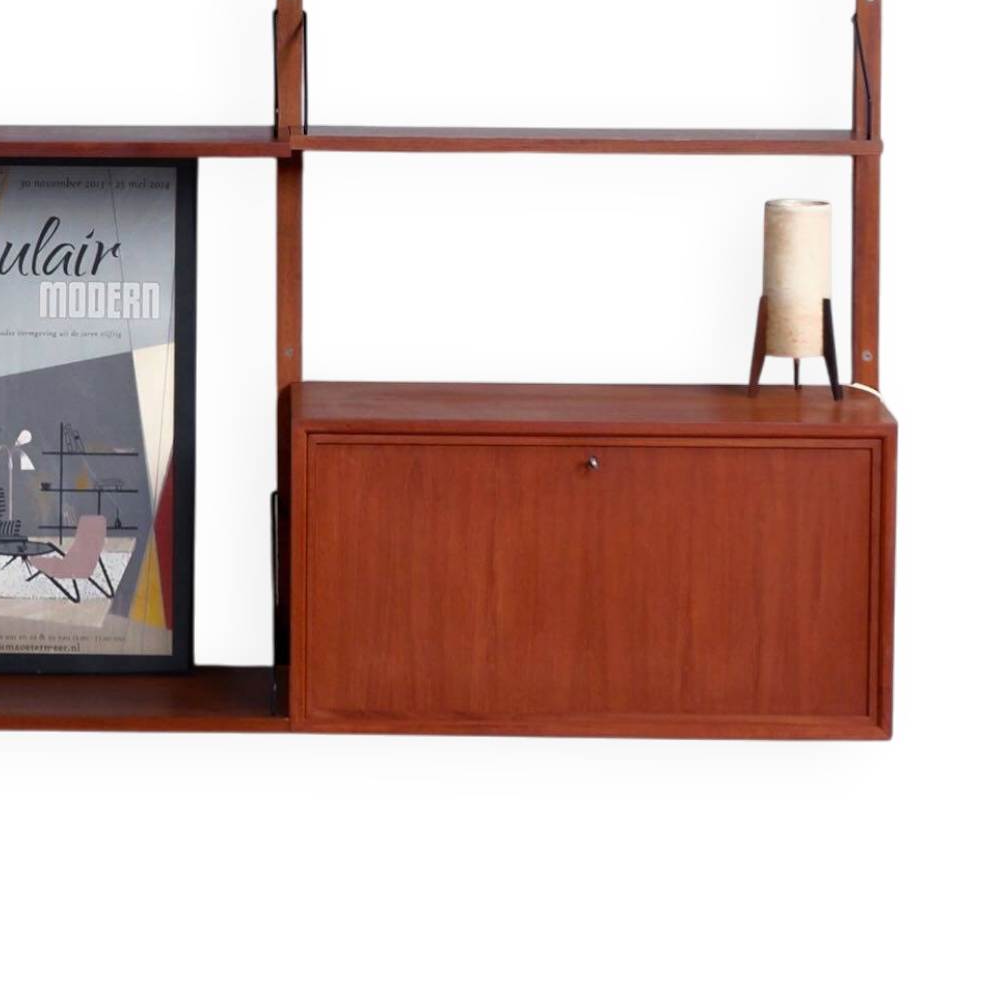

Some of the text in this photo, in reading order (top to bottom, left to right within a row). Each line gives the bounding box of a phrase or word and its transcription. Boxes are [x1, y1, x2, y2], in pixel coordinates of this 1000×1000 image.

[34, 177, 82, 188] november
[128, 178, 146, 189] mei
[149, 181, 170, 190] 2014
[38, 281, 161, 319] MODERN
